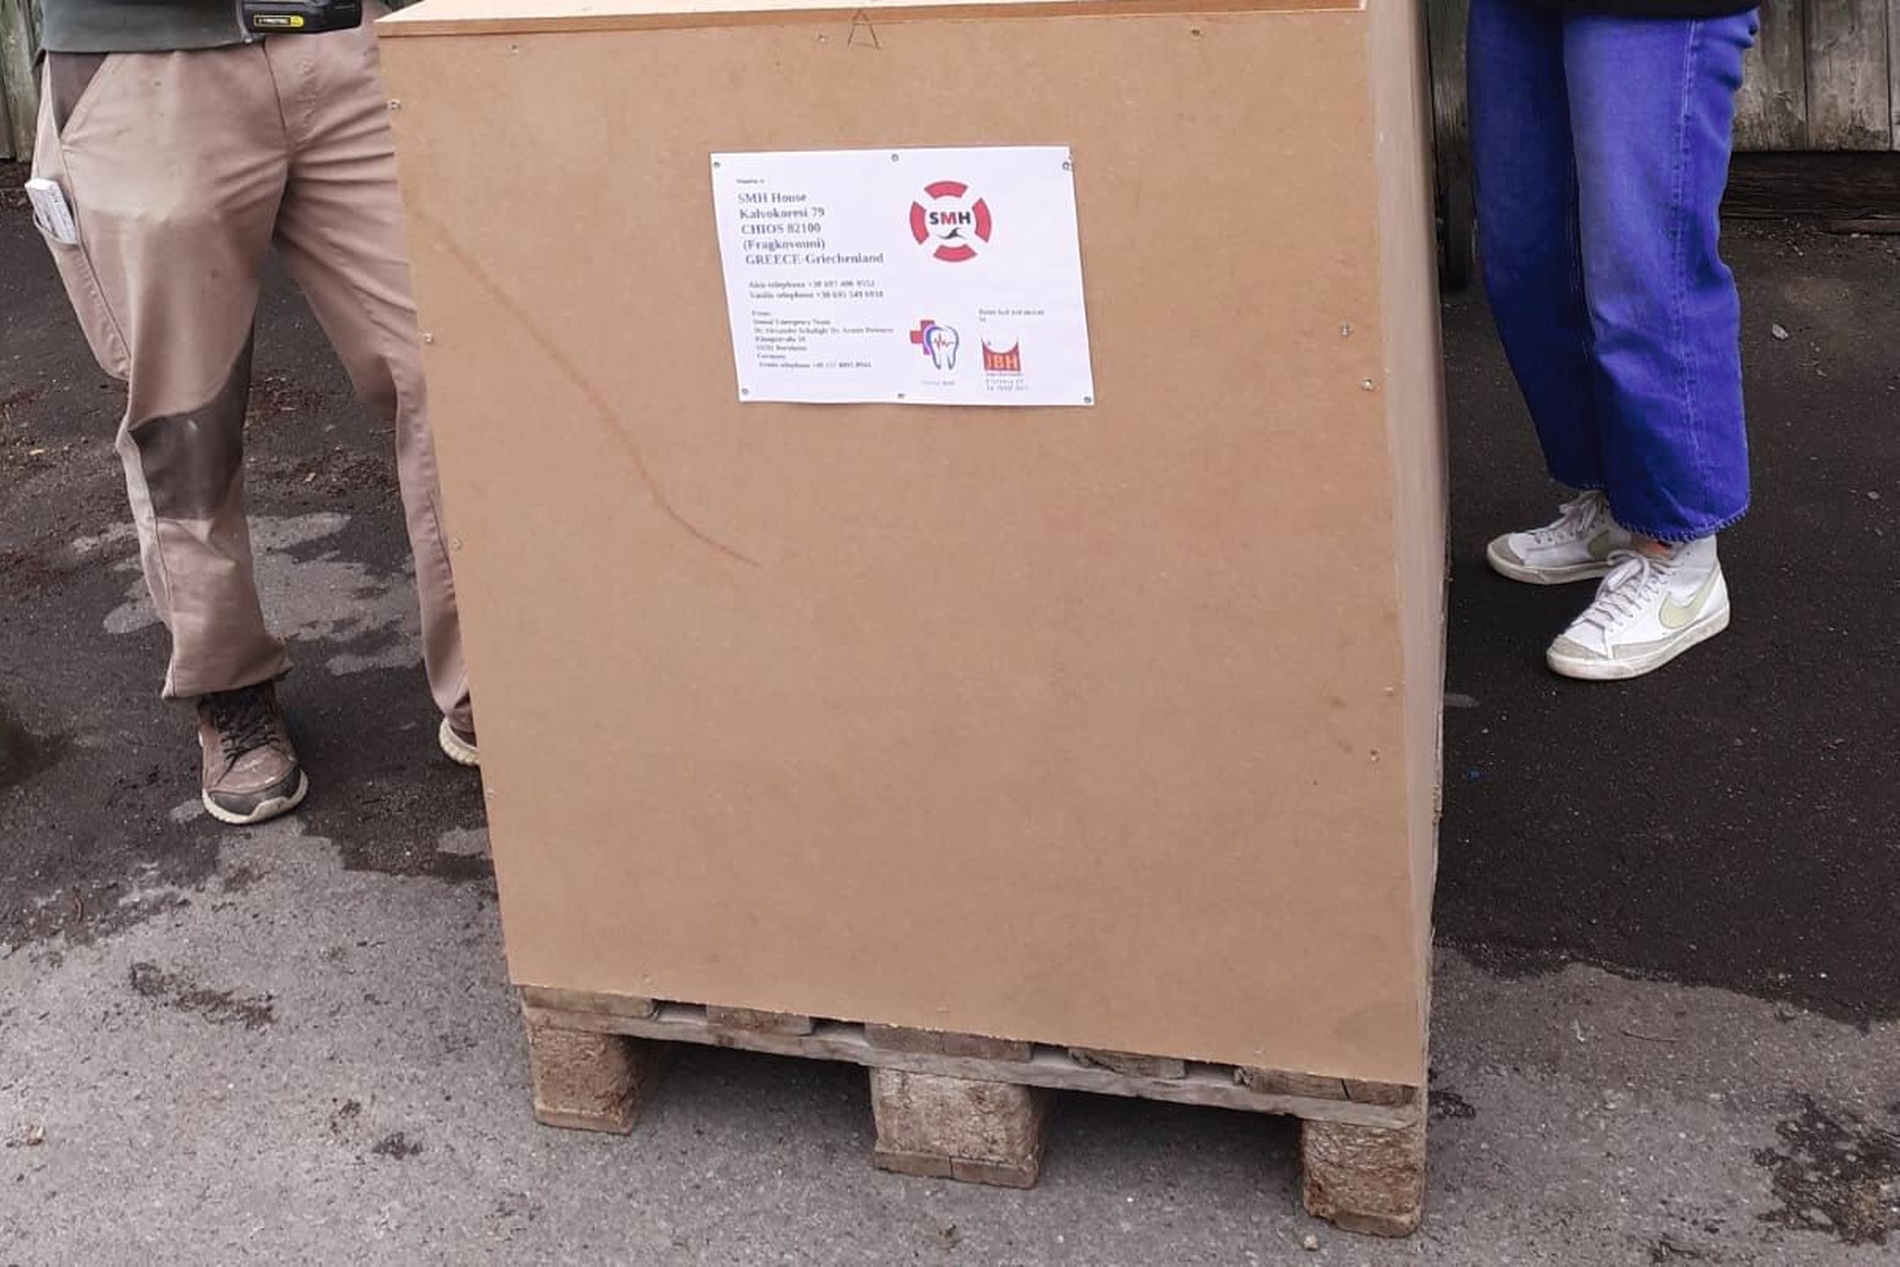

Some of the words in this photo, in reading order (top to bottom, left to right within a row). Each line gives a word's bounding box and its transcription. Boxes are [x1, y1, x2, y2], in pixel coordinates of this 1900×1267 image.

[738, 193, 767, 204] SMH
[772, 193, 807, 203] House
[811, 206, 826, 217] 79
[929, 211, 971, 226] SMH
[741, 224, 784, 235] CHIOS
[788, 222, 822, 234] 82100
